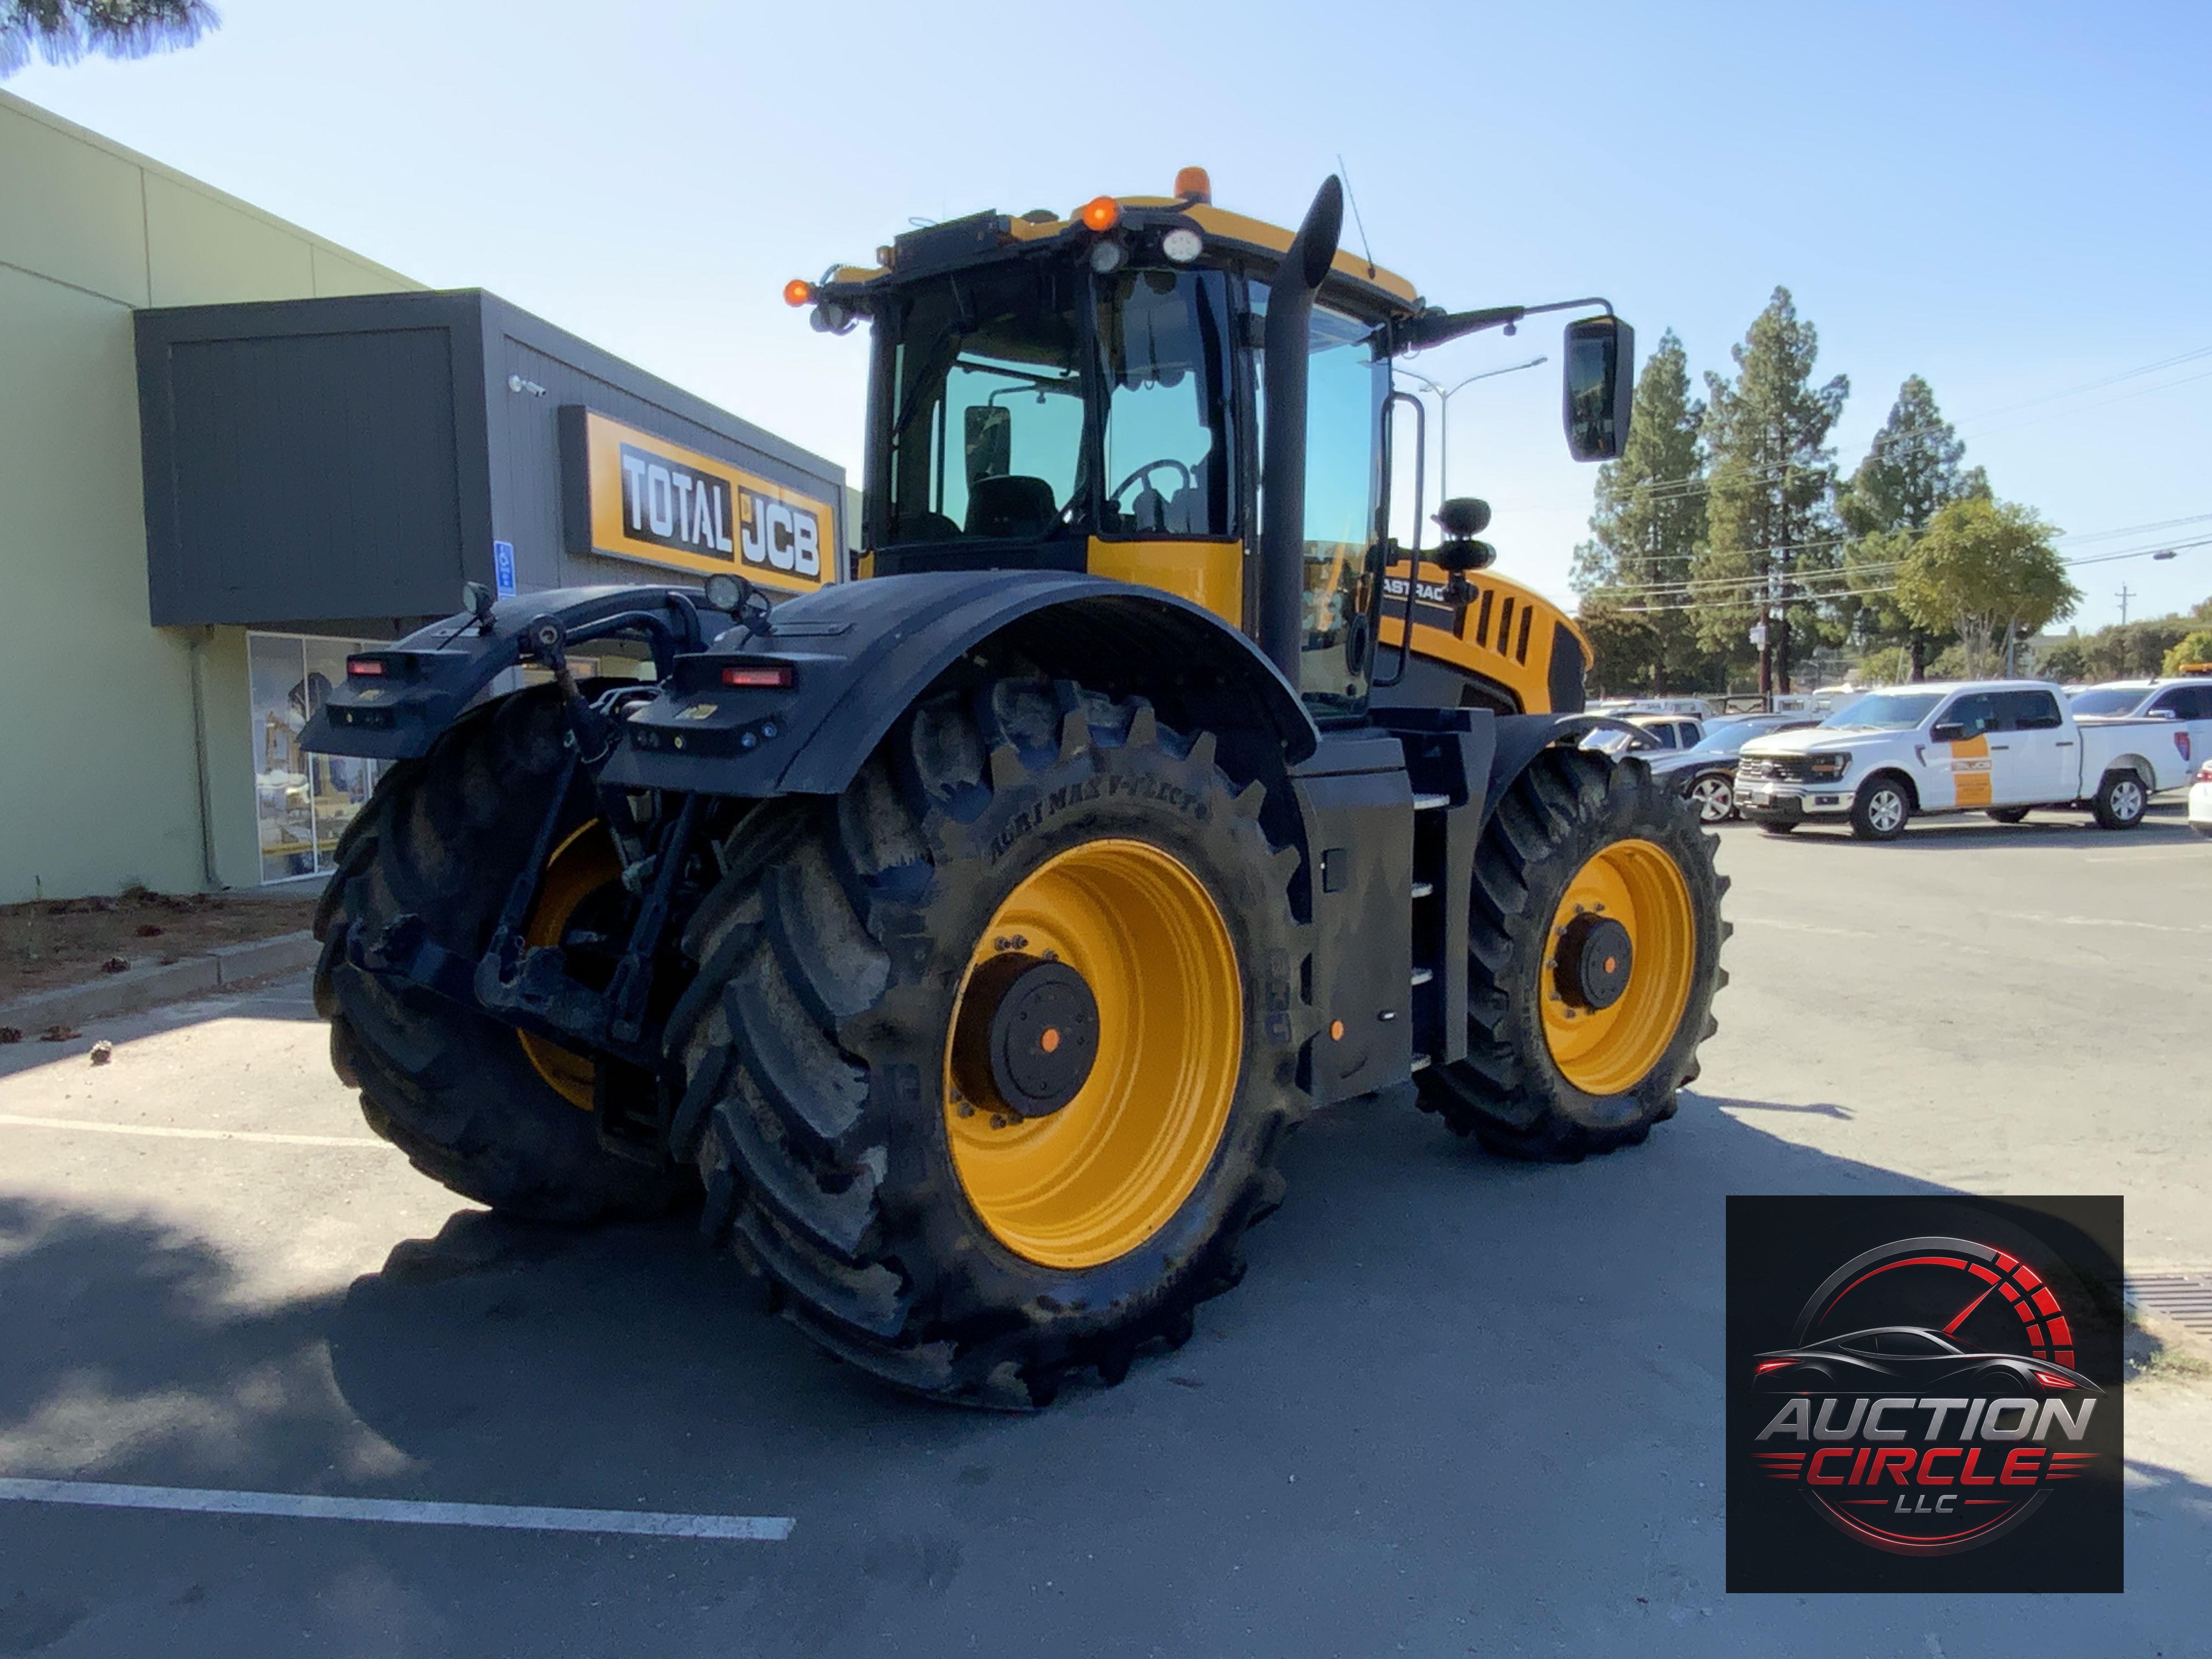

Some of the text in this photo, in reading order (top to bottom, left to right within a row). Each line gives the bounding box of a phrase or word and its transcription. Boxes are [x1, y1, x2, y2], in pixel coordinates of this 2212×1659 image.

[624, 454, 820, 576] TOTAL JCB
[1384, 578, 1445, 601] ASTRAC
